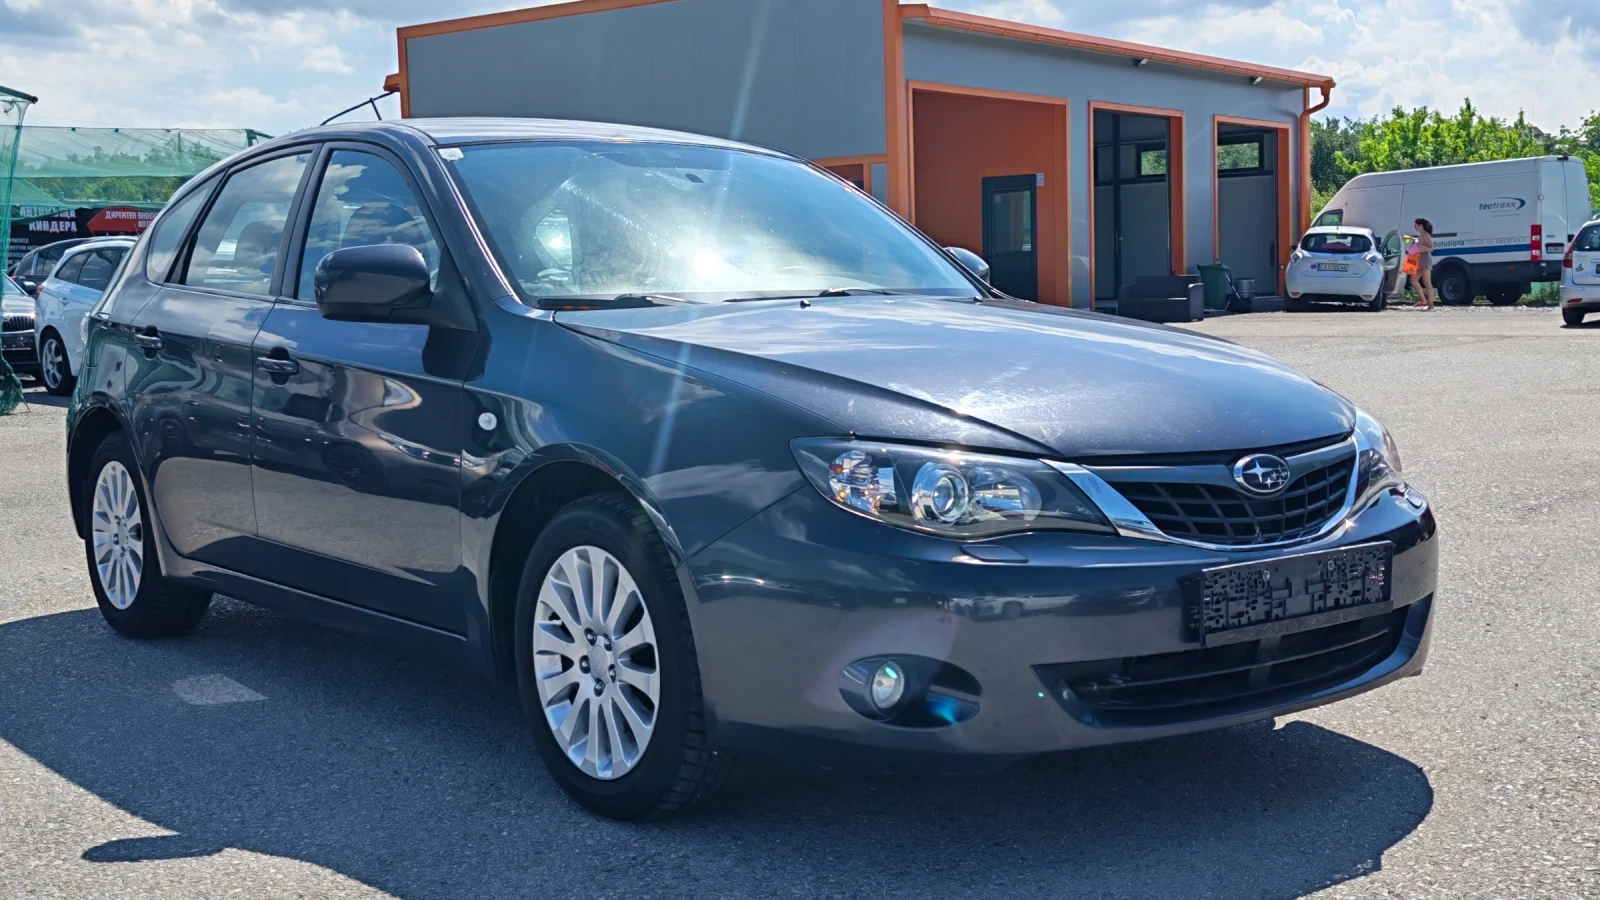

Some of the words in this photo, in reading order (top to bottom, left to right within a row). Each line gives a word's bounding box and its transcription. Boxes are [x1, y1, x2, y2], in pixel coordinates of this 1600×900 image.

[1478, 201, 1517, 211] tectraxx
[20, 206, 76, 219] АВТОКЩА
[105, 211, 137, 220] ДИРЕКТЕН
[29, 220, 78, 233] КИНДЕРА
[1432, 239, 1465, 248] Solutions
